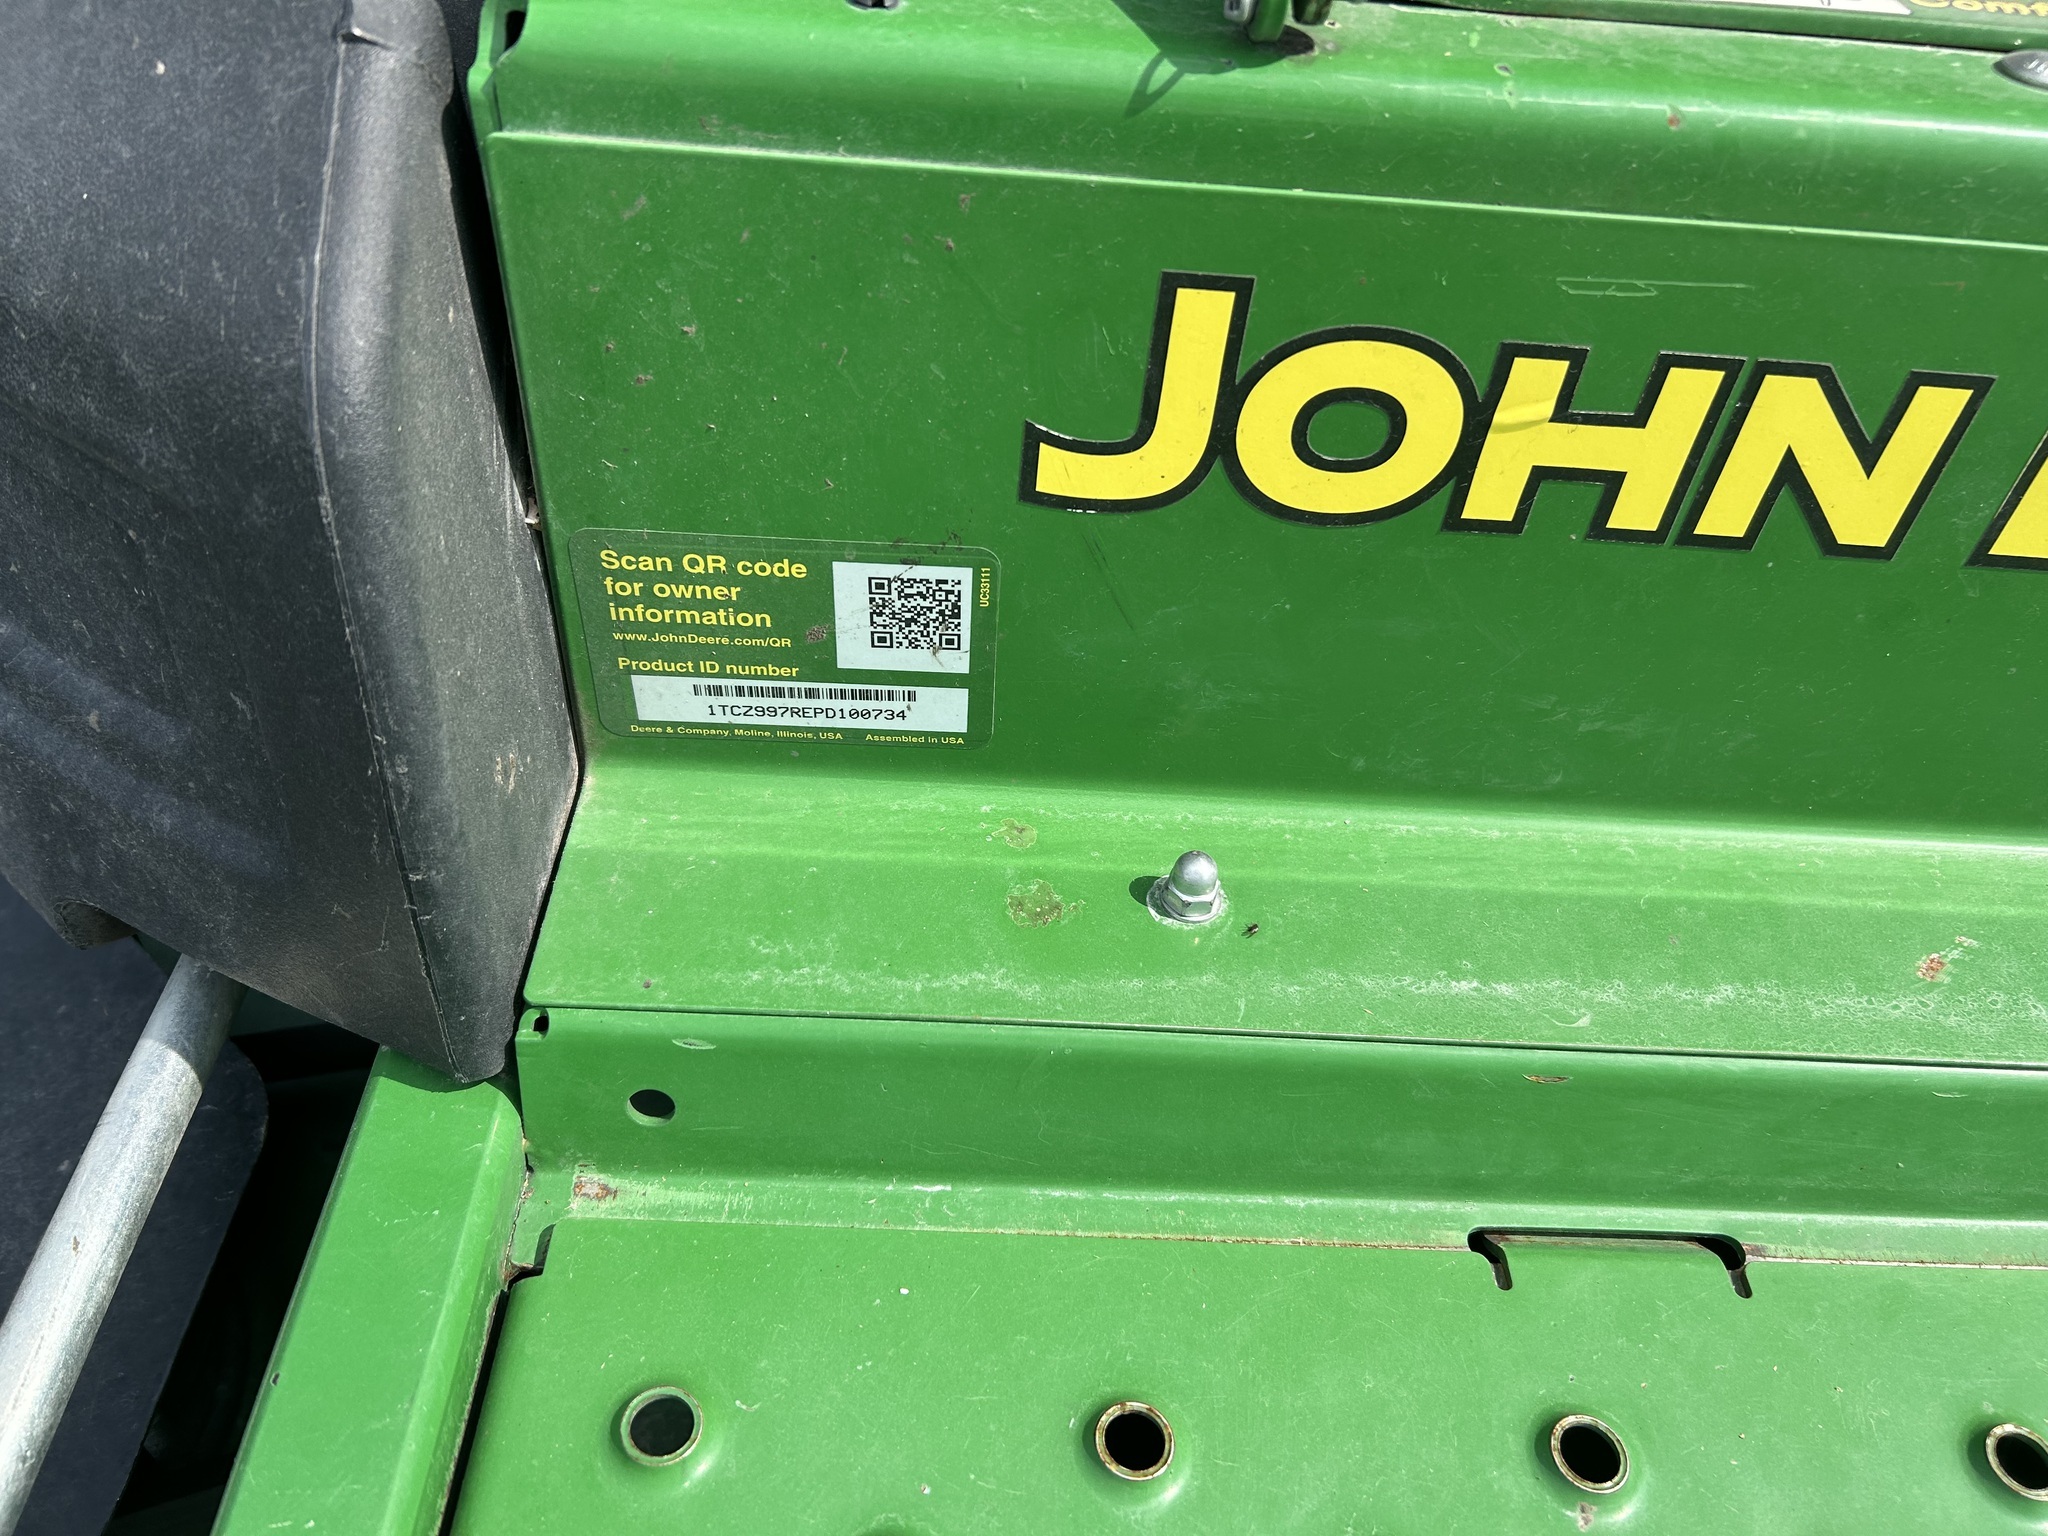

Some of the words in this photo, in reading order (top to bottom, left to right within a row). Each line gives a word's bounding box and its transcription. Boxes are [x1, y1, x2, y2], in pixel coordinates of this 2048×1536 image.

[1020, 271, 1995, 558] JOHN
[600, 549, 673, 572] Scan
[682, 553, 728, 575] QR
[736, 559, 808, 579] code
[604, 577, 644, 596] for
[653, 582, 742, 601] owner
[979, 567, 990, 607] UC33111
[609, 602, 772, 628] information
[612, 632, 792, 648] www.JohnDeere.com/QR
[617, 657, 694, 673] Product
[699, 661, 719, 673] ID
[726, 664, 799, 677] number
[708, 704, 907, 721] 1TCZ997REPD100734
[630, 724, 662, 734] Deere
[666, 726, 674, 735] &
[734, 729, 774, 739] Moline,
[819, 732, 843, 740] USA
[865, 734, 925, 743] Assembled
[940, 736, 965, 745] USA
